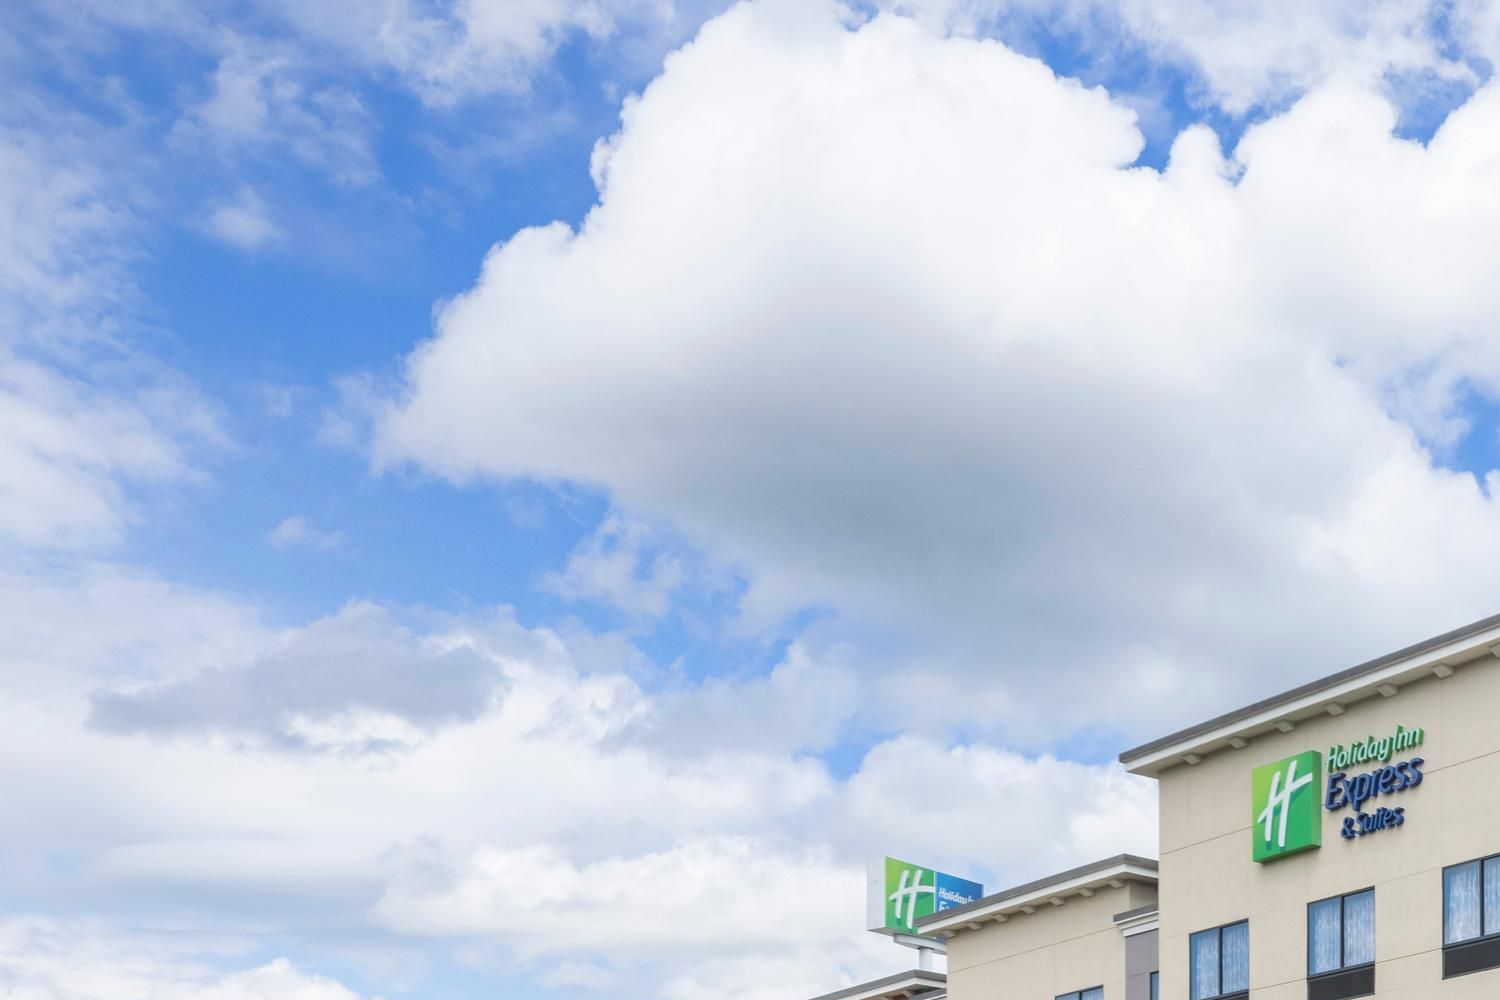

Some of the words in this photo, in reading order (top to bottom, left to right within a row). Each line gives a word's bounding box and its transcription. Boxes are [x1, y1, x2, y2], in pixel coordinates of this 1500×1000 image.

[1326, 735, 1393, 772] Holiday
[1392, 725, 1424, 752] Inn
[1325, 757, 1424, 812] Express
[1341, 816, 1357, 839] &
[1356, 806, 1405, 836] Suites
[938, 886, 968, 904] Holiday
